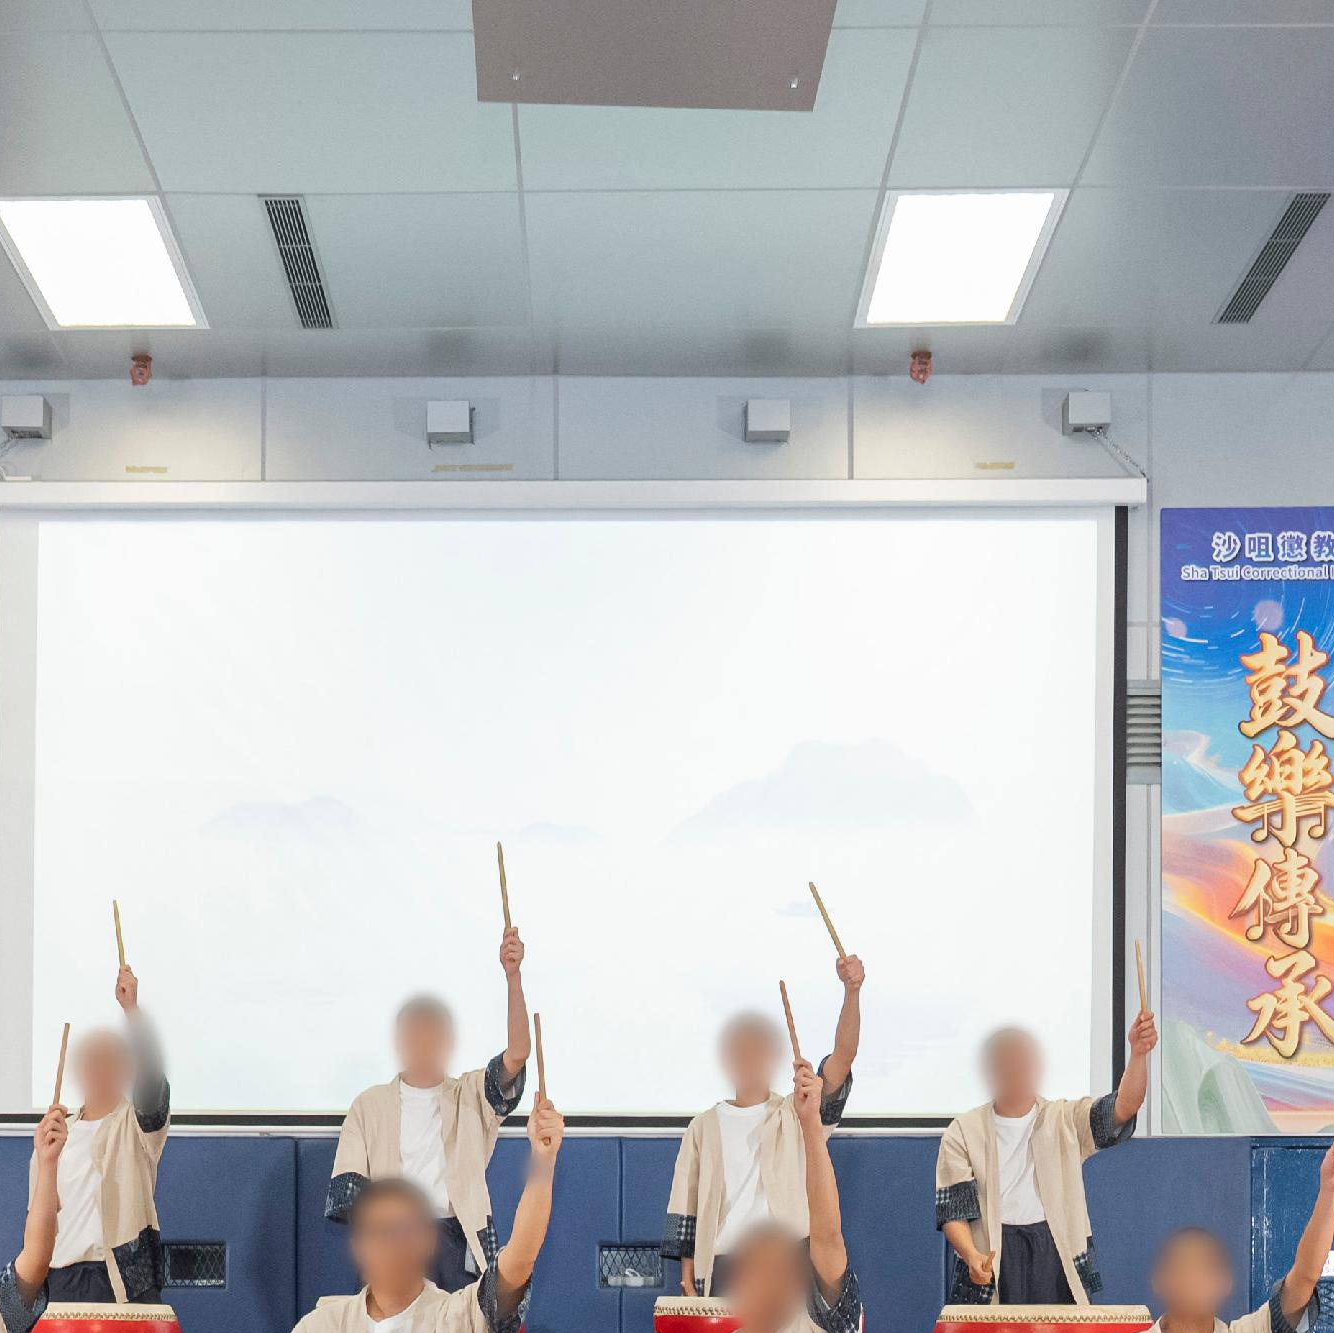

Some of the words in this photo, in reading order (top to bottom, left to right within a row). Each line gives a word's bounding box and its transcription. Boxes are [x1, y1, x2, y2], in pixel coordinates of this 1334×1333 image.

[1181, 565, 1209, 580] Sha
[1210, 565, 1240, 580] Tsui
[1241, 565, 1329, 580] Correctional
